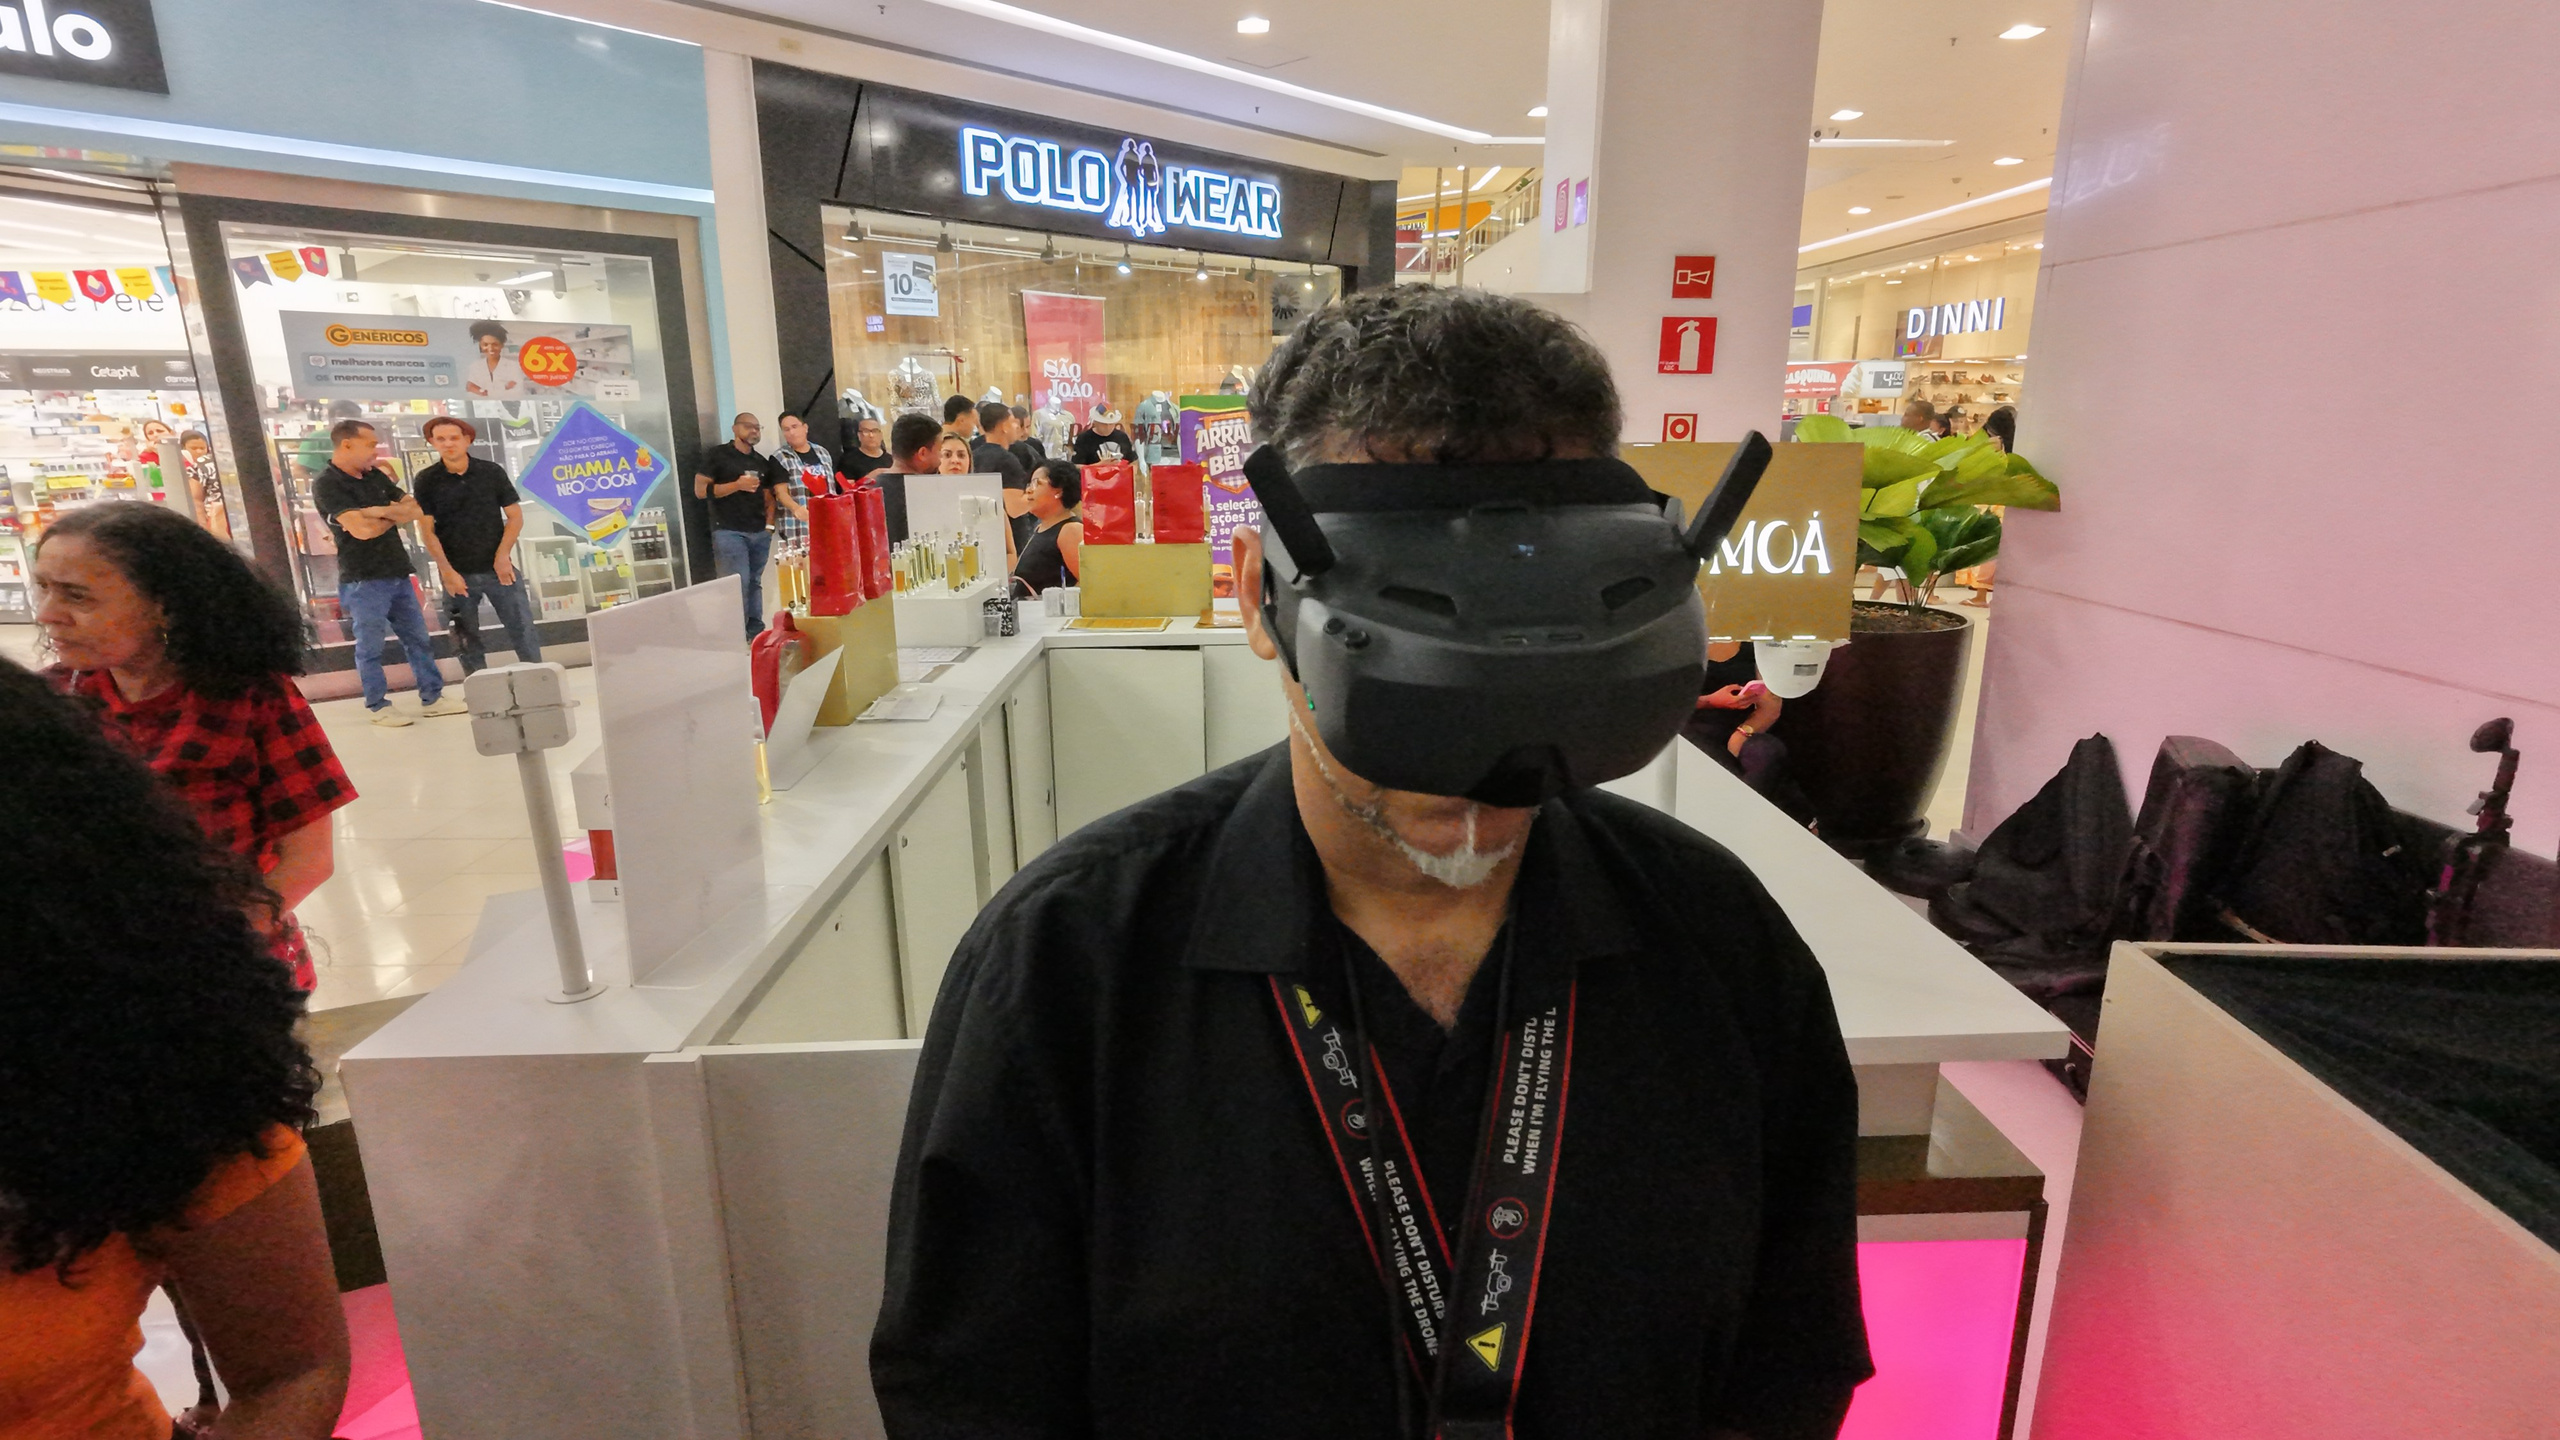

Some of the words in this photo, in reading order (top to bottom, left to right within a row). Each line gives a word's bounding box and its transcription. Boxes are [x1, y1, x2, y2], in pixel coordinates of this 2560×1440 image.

[961, 126, 1111, 214] POLO
[1165, 166, 1283, 239] WEAR
[888, 272, 913, 296] 10
[1906, 296, 2006, 340] DINNI
[331, 358, 384, 368] melhores
[385, 360, 426, 368] marcas
[523, 344, 570, 373] 6x
[1043, 357, 1082, 379] SÃO
[90, 365, 140, 380] Cetaphil
[334, 374, 383, 383] menores
[386, 375, 426, 385] preços
[1784, 368, 1837, 387] ASQUINHA
[1047, 378, 1093, 398] JOÃO
[1223, 444, 1240, 455] DO
[552, 458, 614, 481] CHAMA
[617, 456, 631, 473] A
[1216, 498, 1259, 513] seleção
[1220, 527, 1231, 536] se
[1700, 510, 1832, 575] MOÁ
[1541, 1018, 1556, 1047] THE
[1534, 1050, 1553, 1101] FLYING
[1503, 1108, 1525, 1165] PLEASE
[1514, 1060, 1533, 1106] DON'T
[1530, 1103, 1546, 1126] I'M
[1522, 1128, 1542, 1176] WHEN
[1383, 1159, 1411, 1214] PLEASE
[1401, 1214, 1427, 1258] DON'T
[1404, 1278, 1424, 1308] THE
